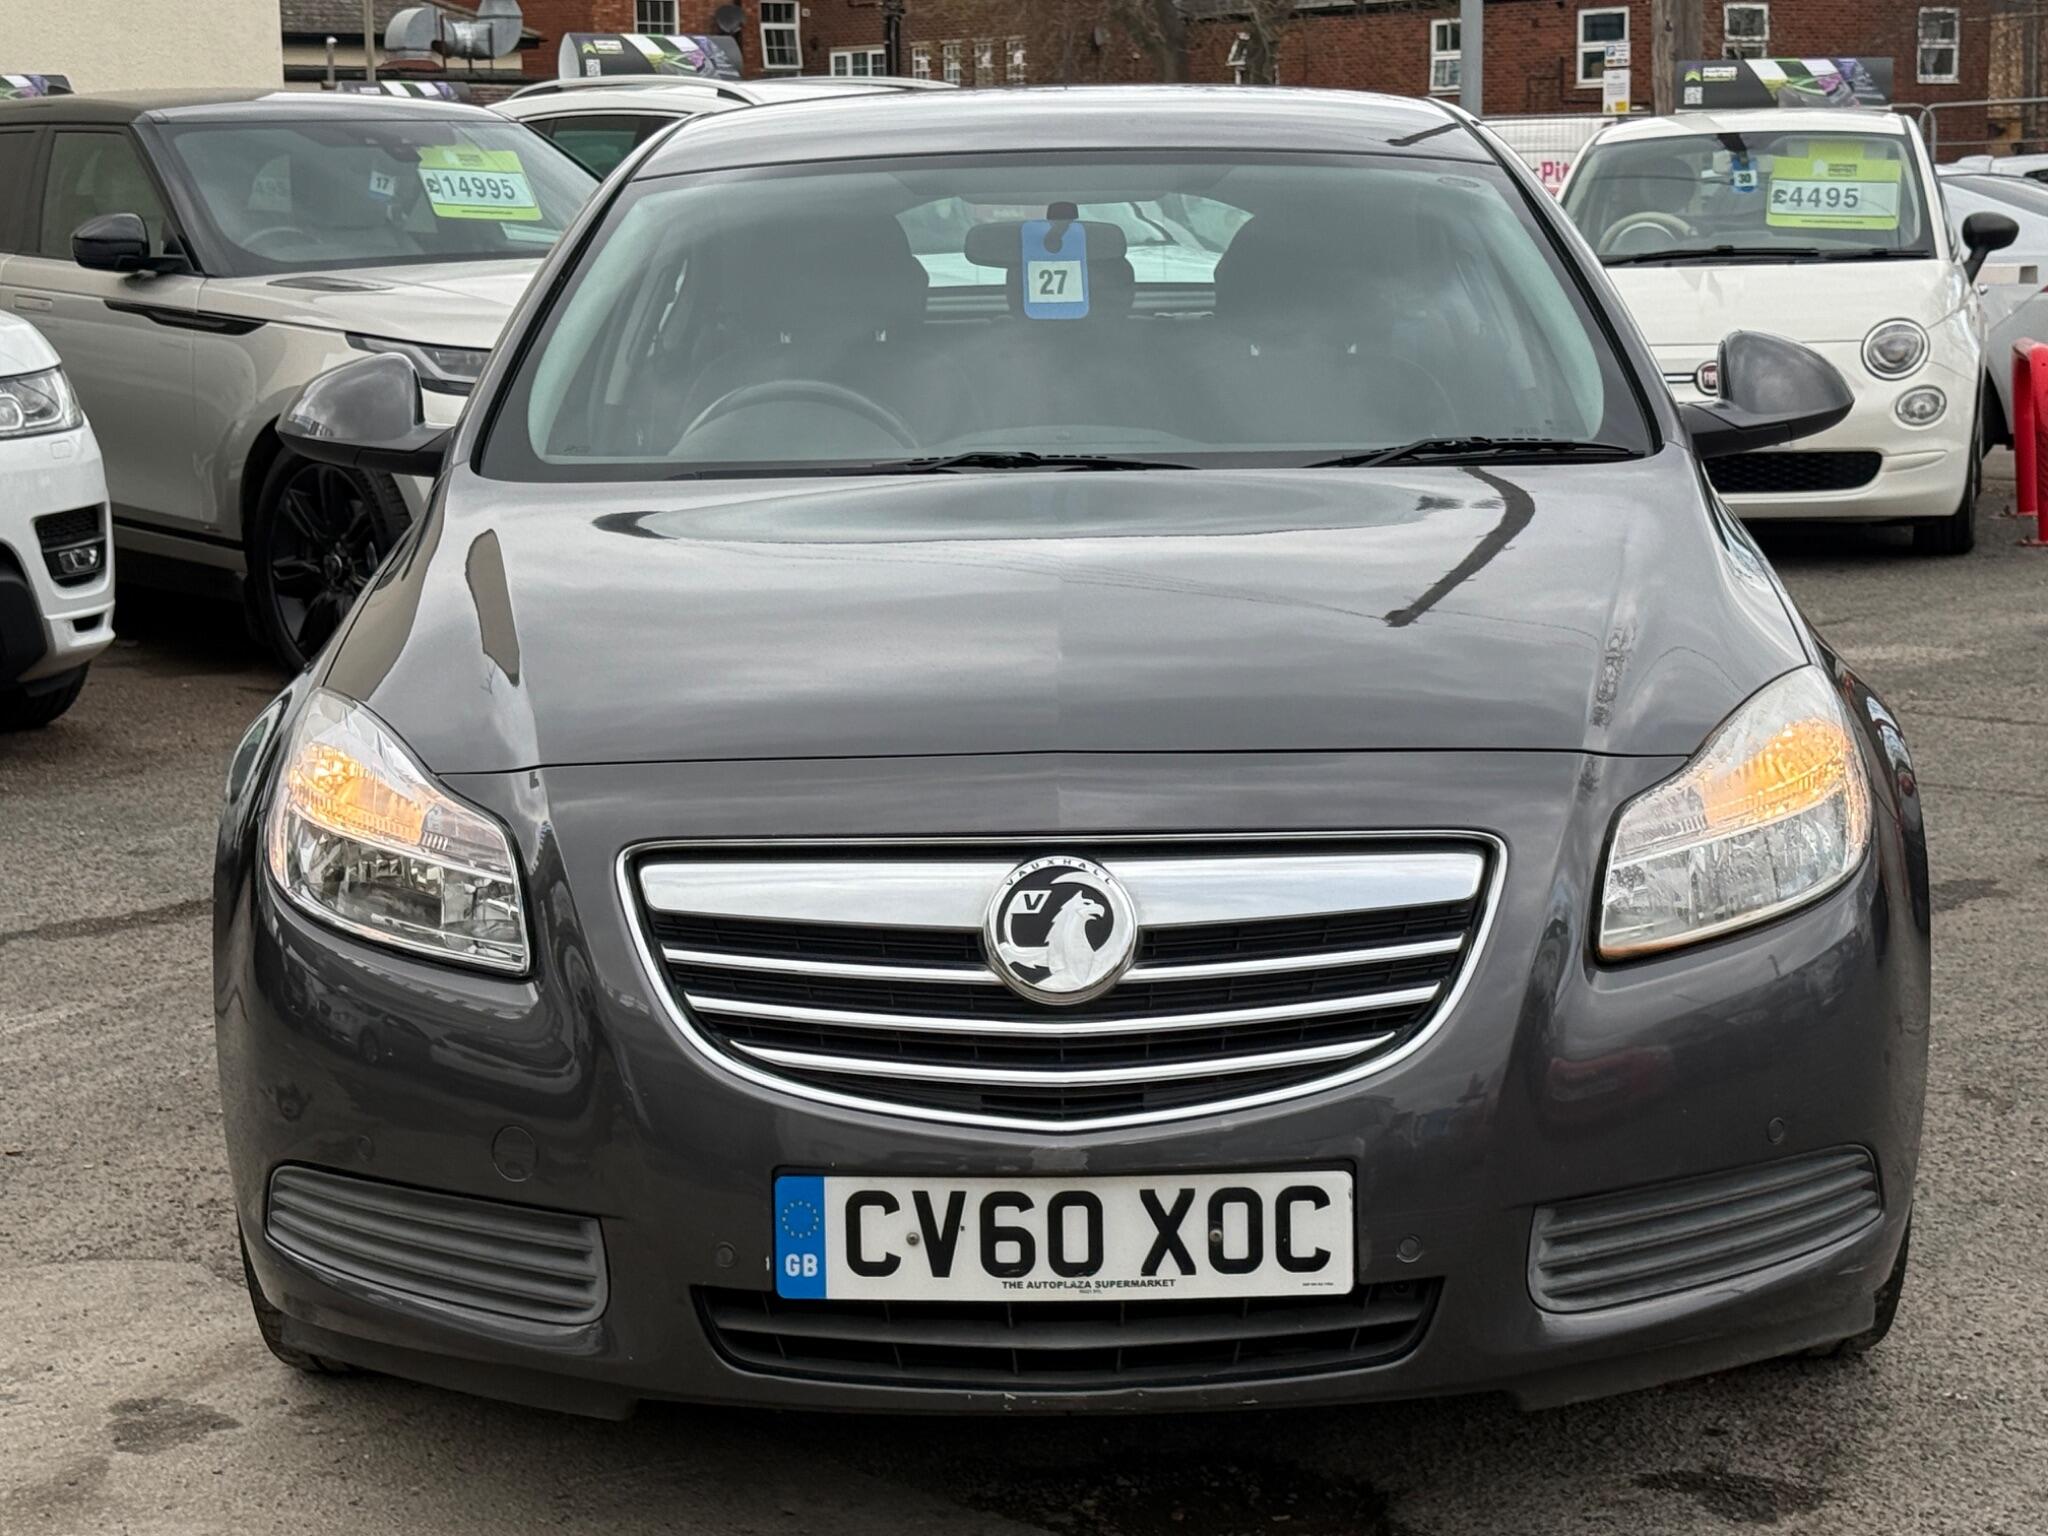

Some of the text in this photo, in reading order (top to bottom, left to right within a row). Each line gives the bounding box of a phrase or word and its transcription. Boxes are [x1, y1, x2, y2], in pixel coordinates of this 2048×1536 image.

[376, 177, 389, 191] 17
[426, 176, 516, 200] £14995
[1738, 173, 1752, 184] 30
[1772, 187, 1859, 208] £4495
[1039, 269, 1068, 295] 27
[1006, 859, 1112, 886] VAUXHALL
[1024, 894, 1044, 910] V
[845, 1186, 1332, 1278] CV60 XOC
[785, 1253, 818, 1277] GB
[1002, 1279, 1176, 1289] THE AUTOPLAZA SUPERMARKET
